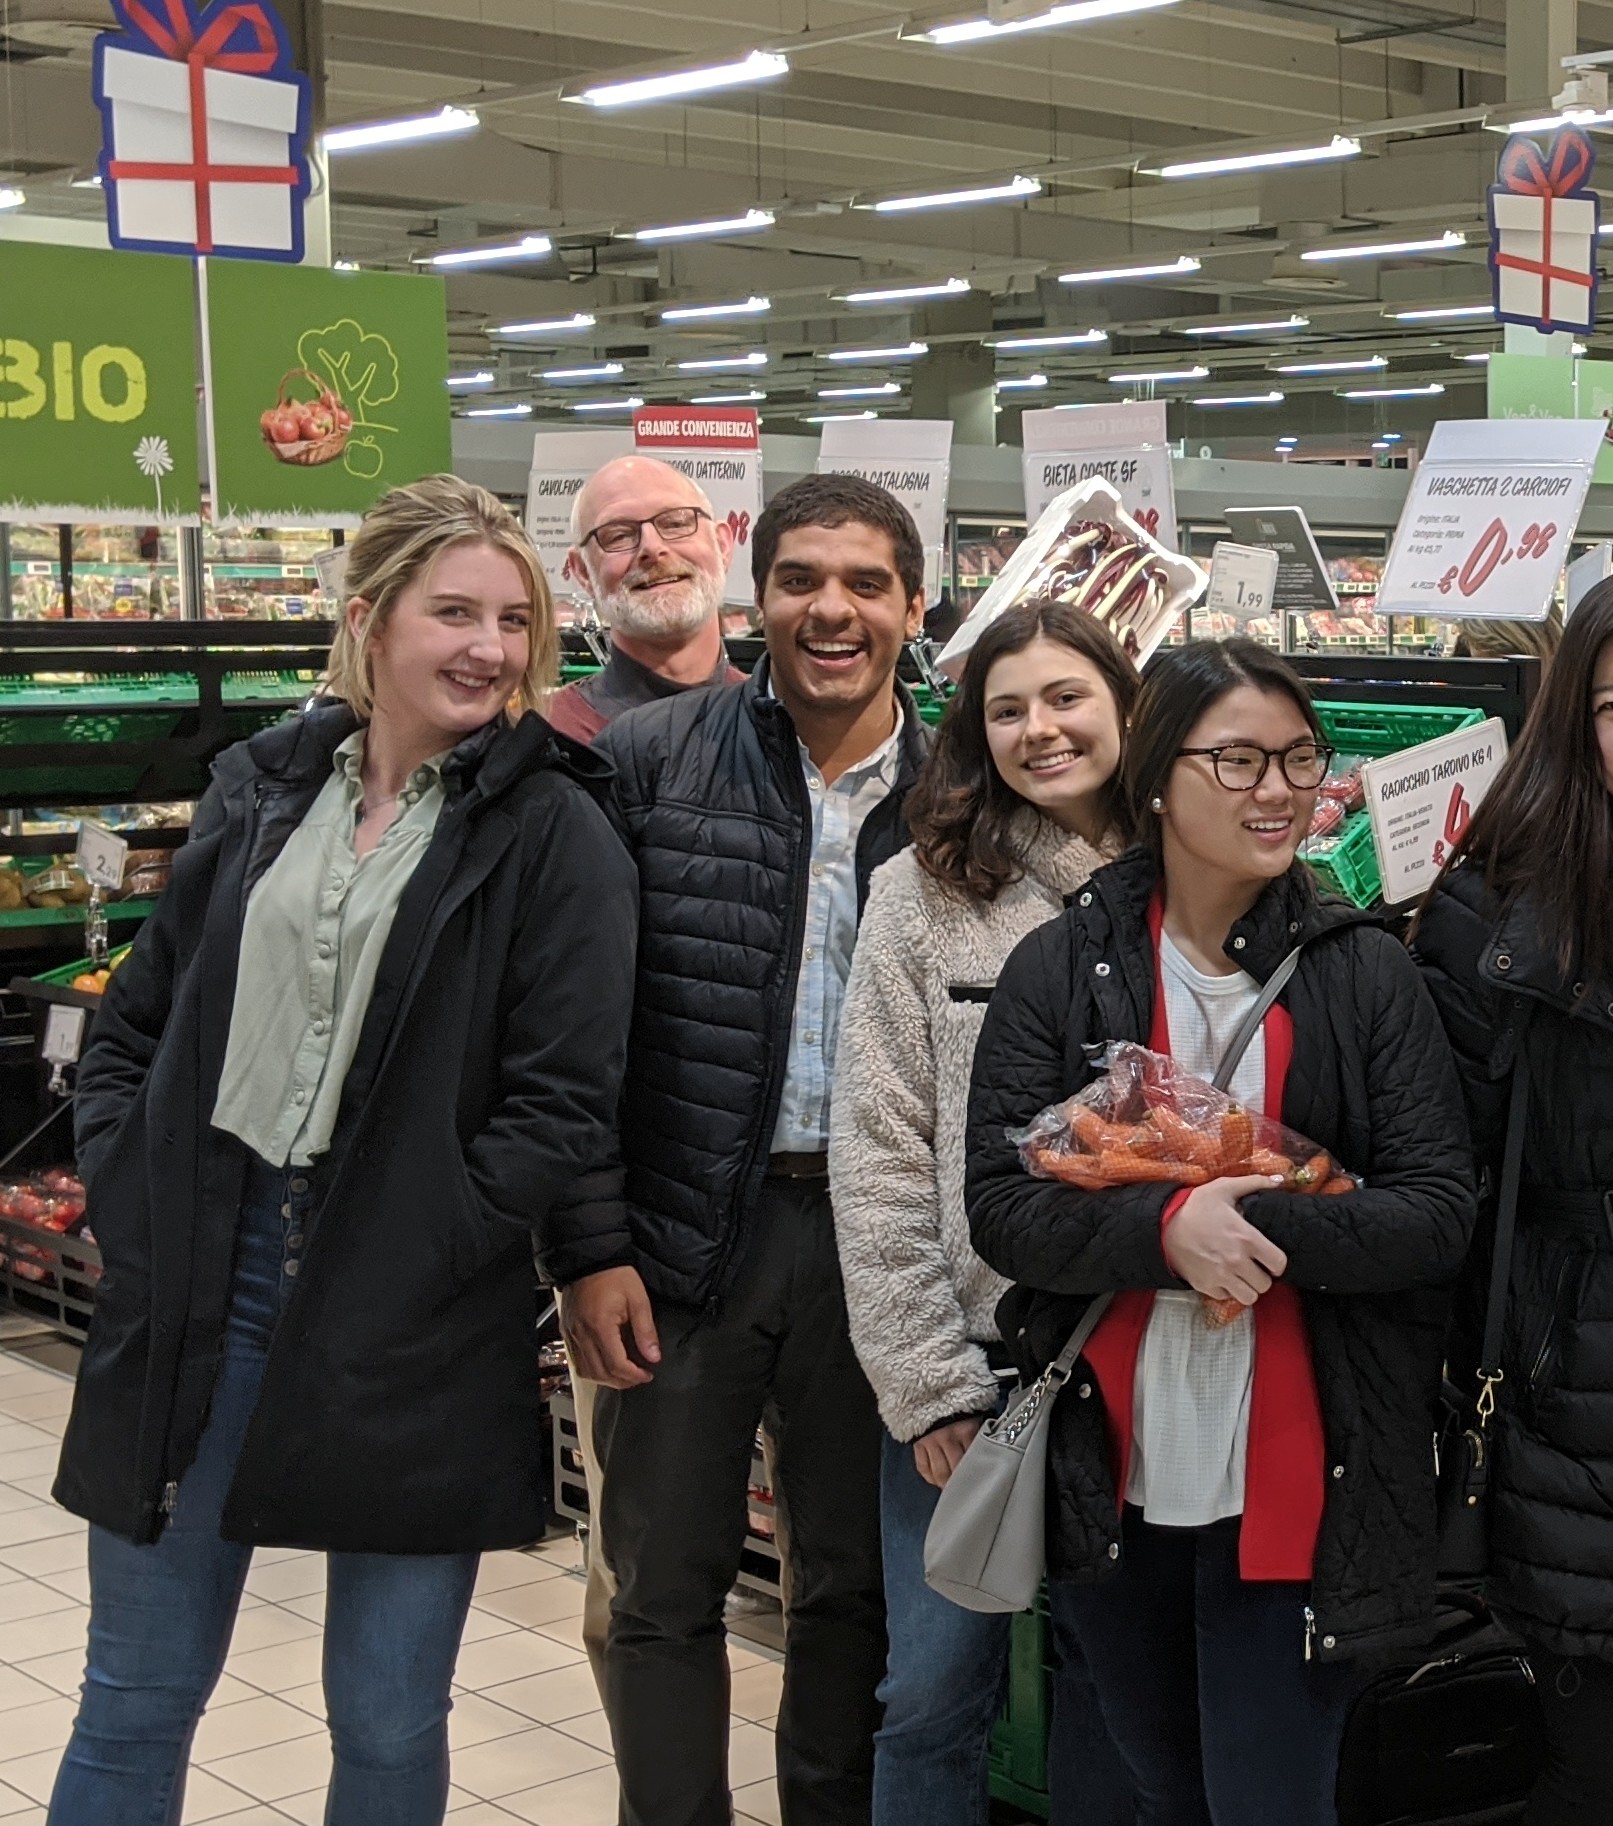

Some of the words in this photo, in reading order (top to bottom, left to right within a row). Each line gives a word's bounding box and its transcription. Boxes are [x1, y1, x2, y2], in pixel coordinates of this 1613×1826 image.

[0, 338, 147, 423] BIO
[638, 420, 680, 436] GRANDE
[681, 420, 754, 438] CONVENIENZA
[696, 461, 746, 480] DATTERINO
[870, 470, 930, 491] CATALOGNA
[1043, 462, 1076, 487] BIETA
[1121, 460, 1138, 485] SF
[1427, 477, 1499, 496] VASCHETTA
[1512, 476, 1572, 497] CARCIOFI
[1237, 581, 1263, 608] 1,99
[1381, 769, 1430, 801] RADICCHIO
[1432, 754, 1470, 782] TARDIVO
[1472, 749, 1485, 767] KG
[1486, 745, 1493, 761] 1
